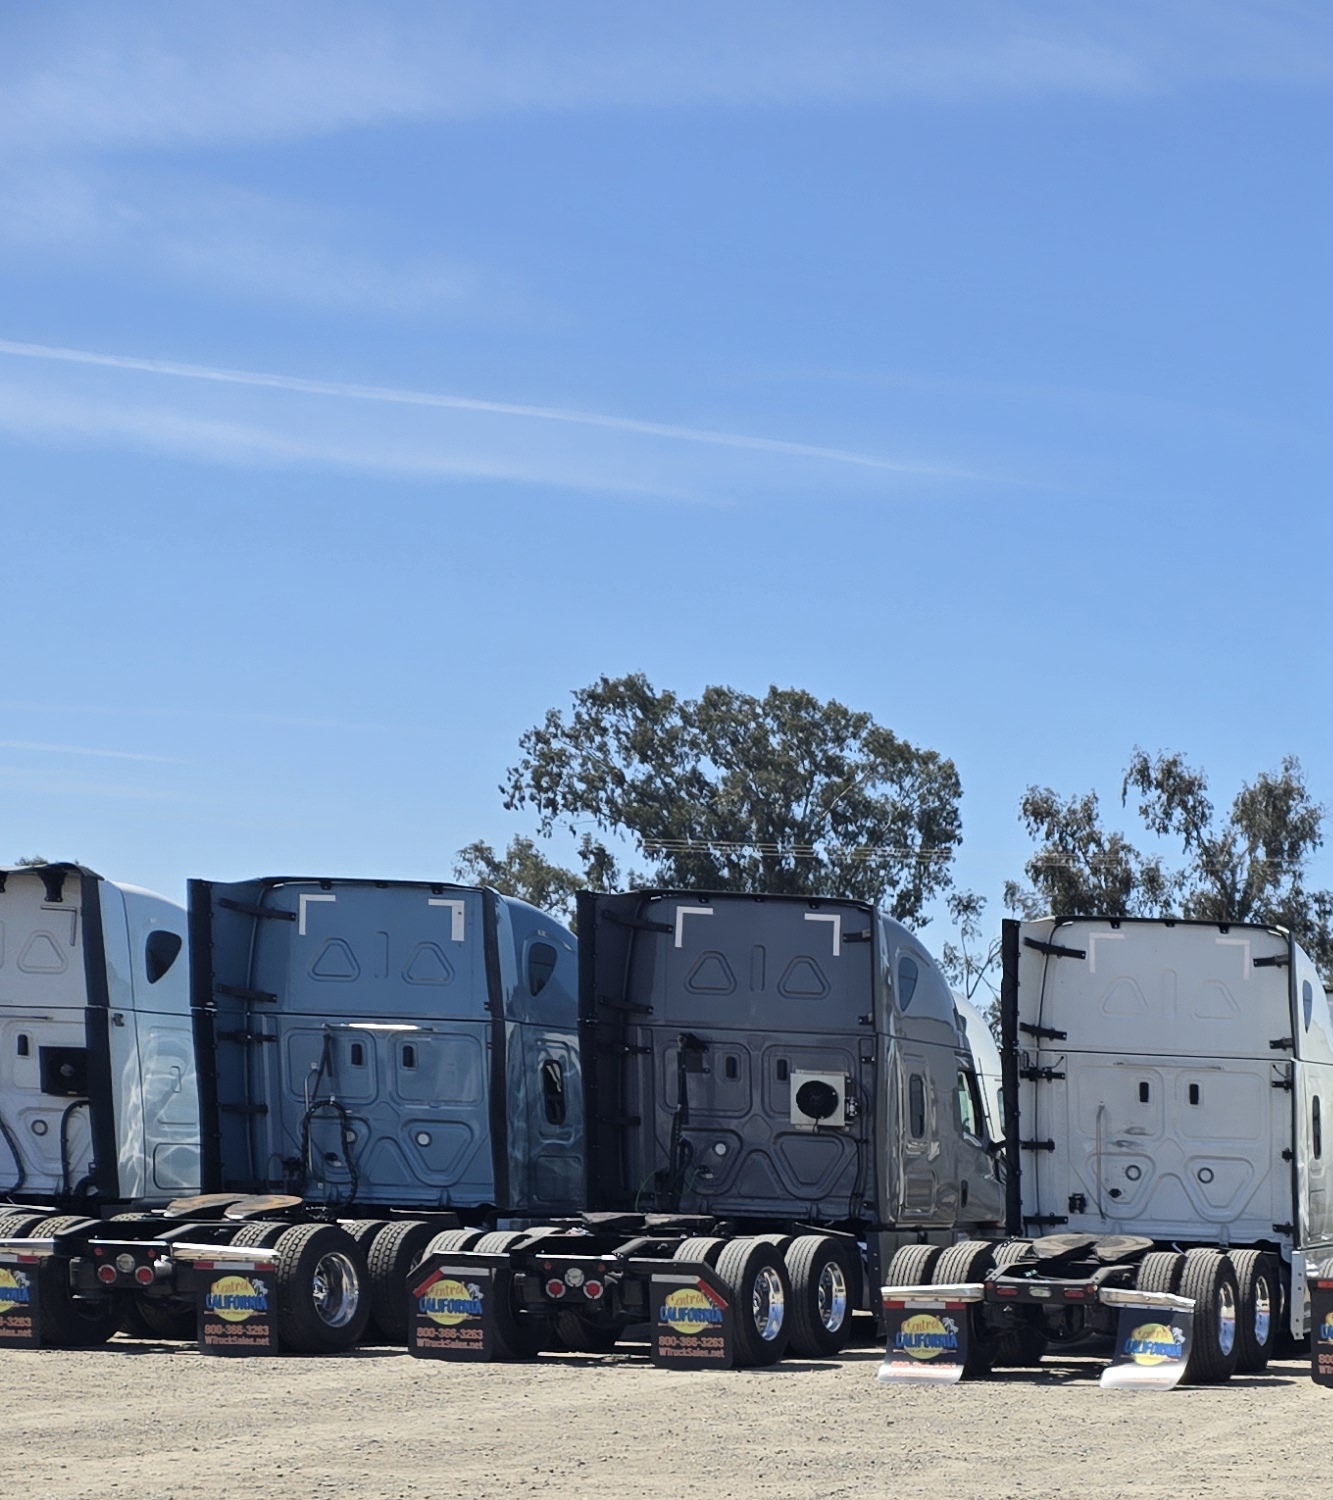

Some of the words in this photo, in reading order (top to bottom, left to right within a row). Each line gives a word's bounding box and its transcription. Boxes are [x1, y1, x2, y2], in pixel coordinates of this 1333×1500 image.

[206, 1293, 268, 1310] CALIFORNIA
[419, 1298, 483, 1314] CALIFORNIA
[660, 1306, 724, 1322] CALIFORNIA
[896, 1332, 958, 1348] CALIFORNIA
